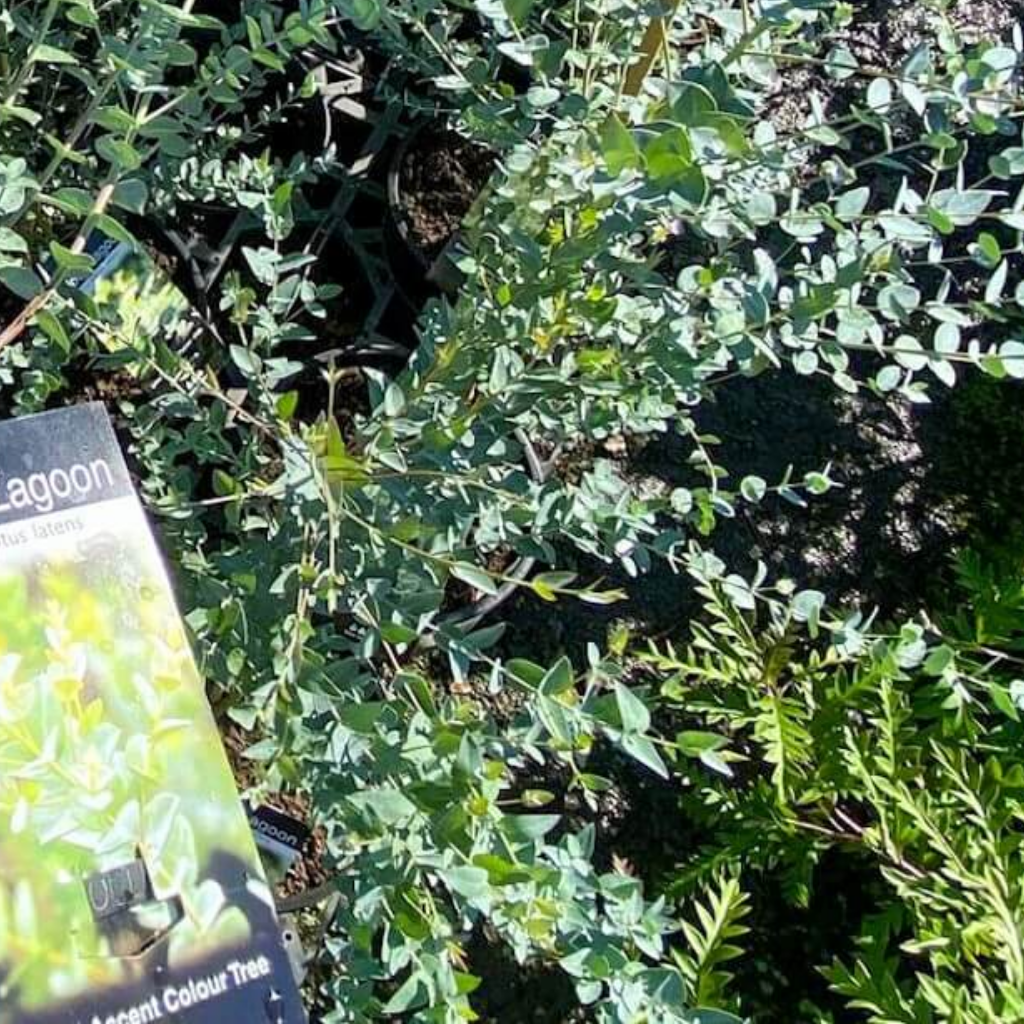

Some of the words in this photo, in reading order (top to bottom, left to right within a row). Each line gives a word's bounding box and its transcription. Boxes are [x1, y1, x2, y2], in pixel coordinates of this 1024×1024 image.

[32, 516, 85, 543] latens
[250, 816, 298, 846] agoon
[163, 971, 228, 1012] Colour
[227, 954, 271, 986] Tree
